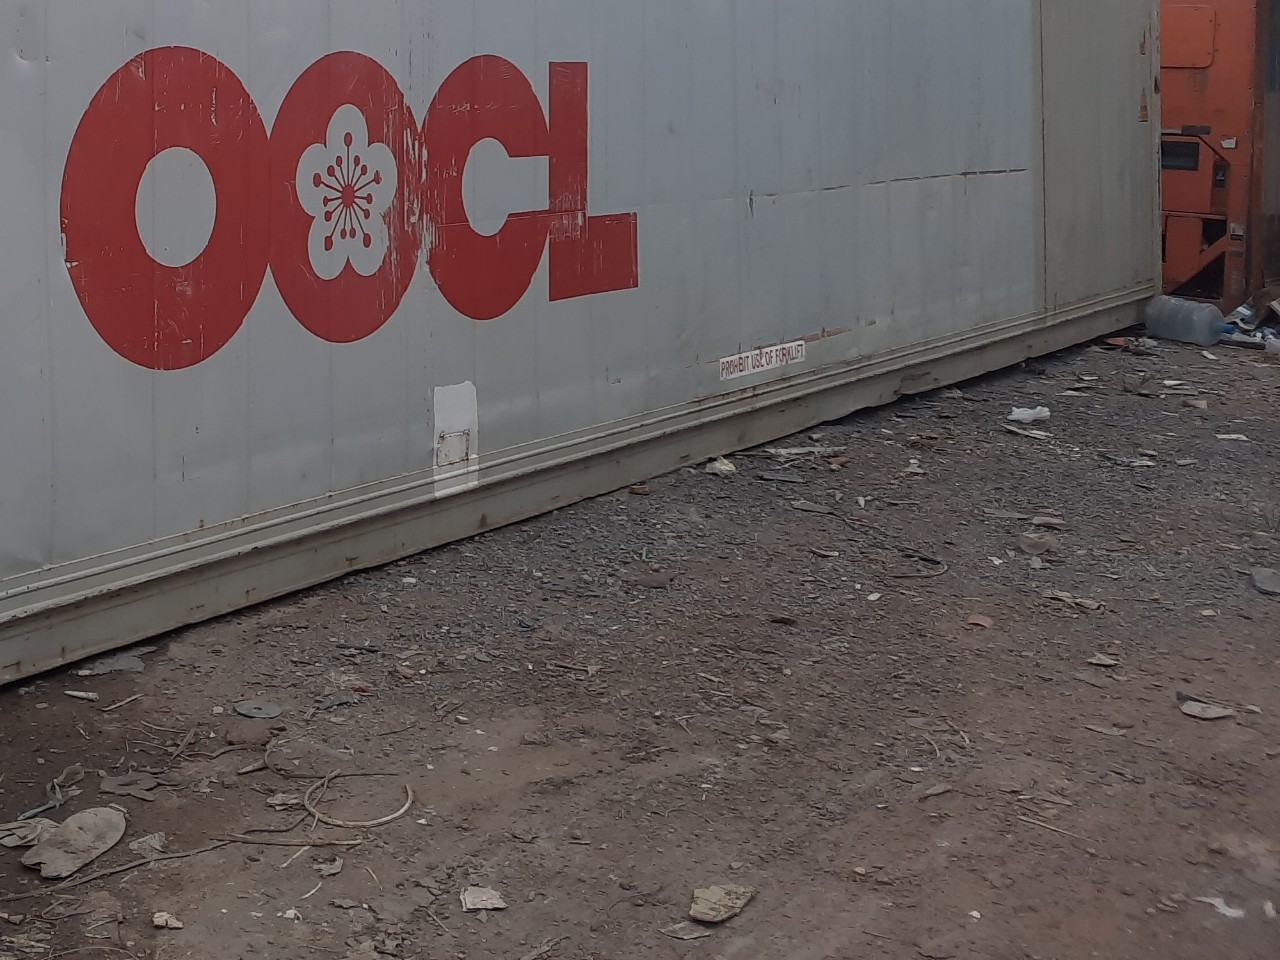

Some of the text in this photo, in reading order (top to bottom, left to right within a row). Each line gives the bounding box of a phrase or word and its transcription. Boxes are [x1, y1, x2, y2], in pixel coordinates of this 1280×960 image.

[60, 45, 639, 371] OOCL
[721, 343, 804, 378] PROHIBIT USE OF FORKLIFT
